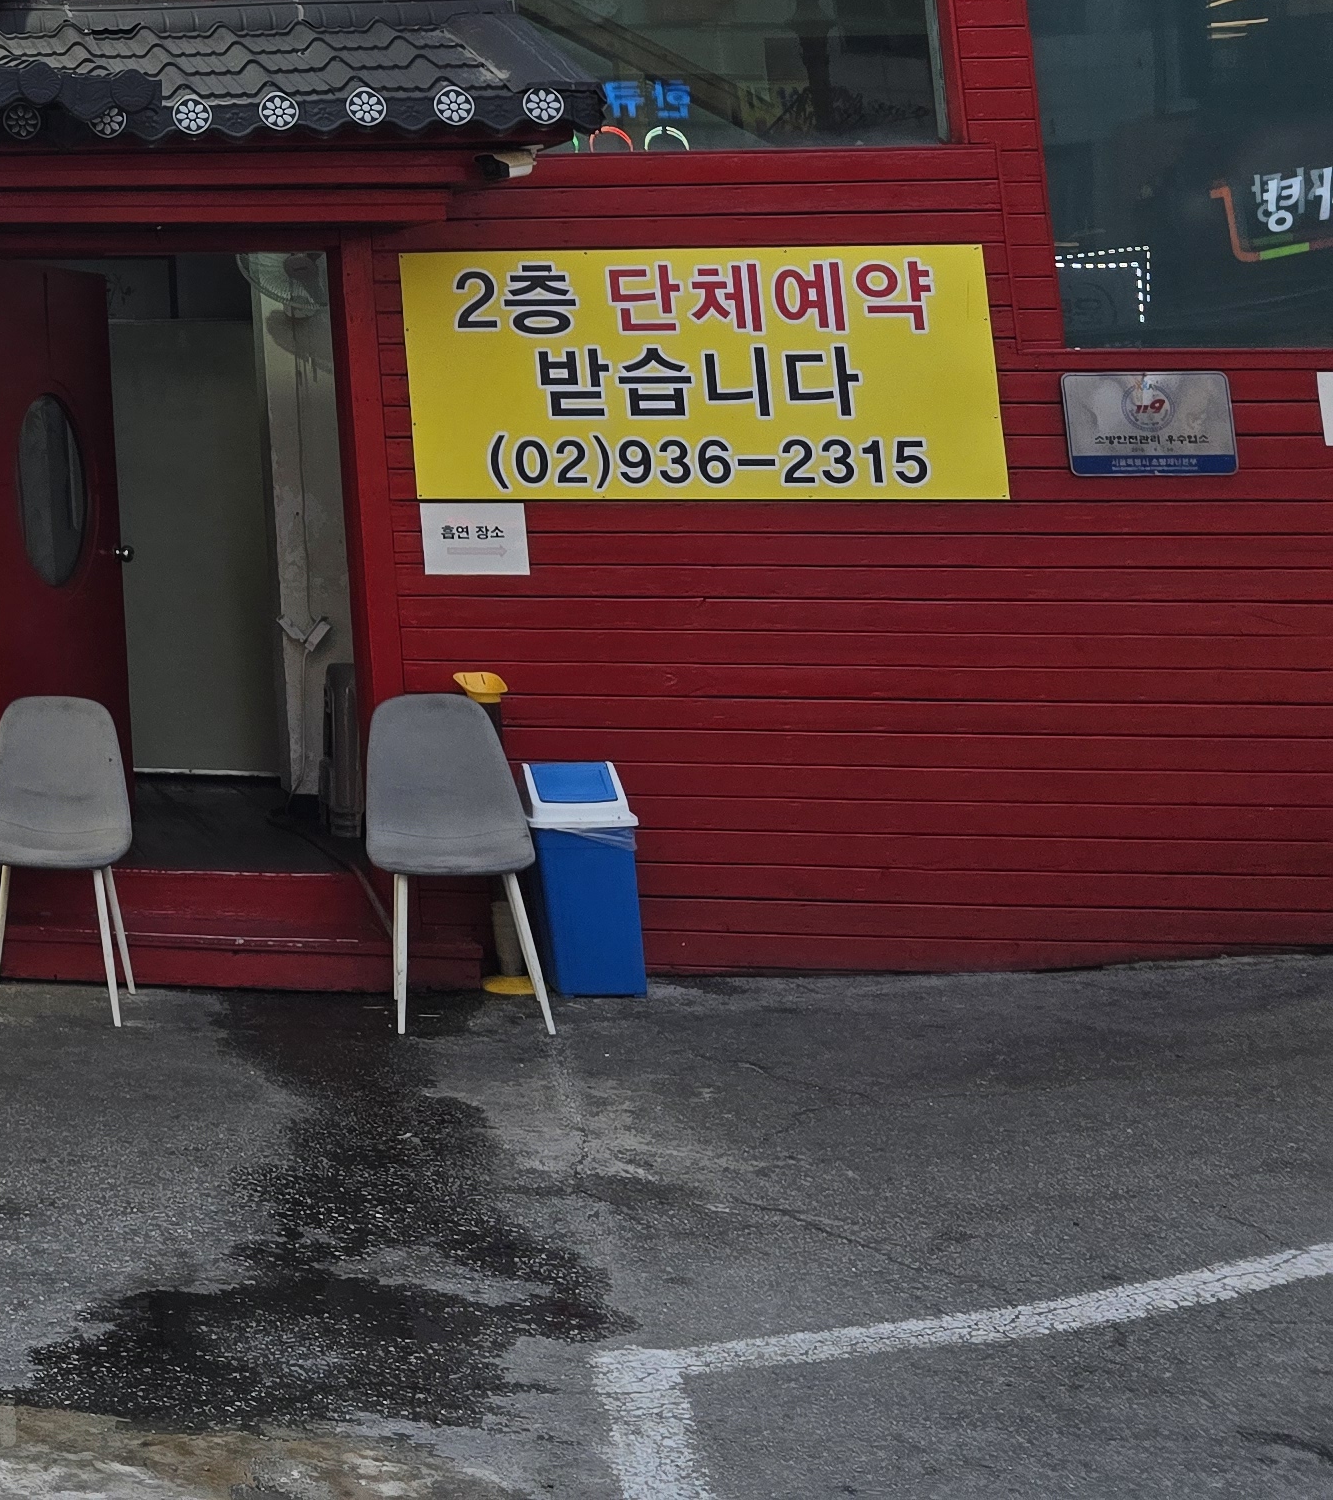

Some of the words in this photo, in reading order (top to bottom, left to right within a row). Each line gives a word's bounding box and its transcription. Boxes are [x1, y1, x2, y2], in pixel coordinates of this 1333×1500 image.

[454, 260, 578, 339] 2층
[606, 258, 935, 335] 단체예약
[535, 344, 863, 420] 받습니다
[487, 431, 932, 491] (02)936-2315
[441, 524, 470, 541] 흡연
[475, 523, 506, 540] 장소
